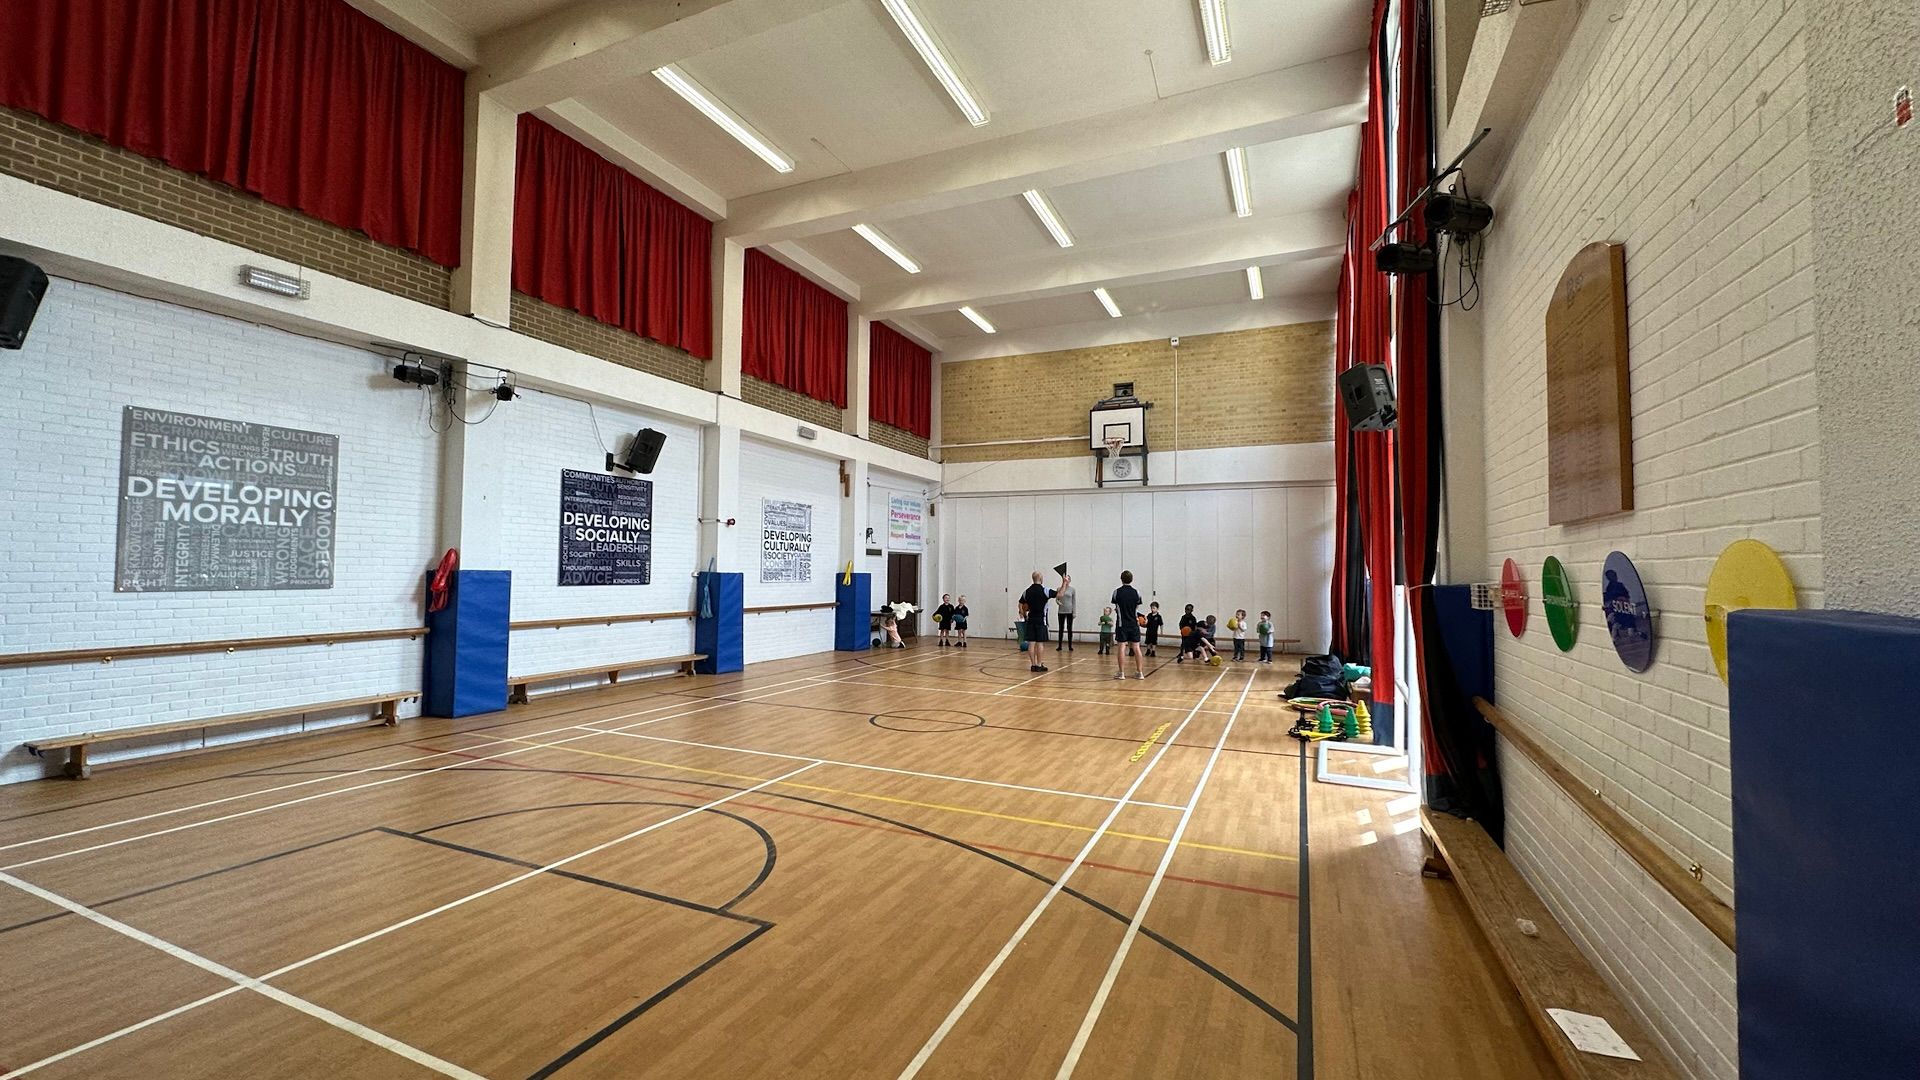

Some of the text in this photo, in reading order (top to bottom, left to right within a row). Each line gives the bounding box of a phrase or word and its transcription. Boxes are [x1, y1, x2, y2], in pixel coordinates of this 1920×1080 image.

[132, 409, 253, 434] ENVIRONMENT
[132, 420, 261, 445] DISCRIMINATION
[271, 430, 333, 447] CULTURE
[130, 432, 221, 455] ETHICS
[221, 443, 260, 452] FEELINGS
[262, 426, 271, 460] REASON
[221, 449, 261, 460] WRONG
[270, 448, 333, 467] TRUTH
[198, 455, 296, 477] ACTIONS
[564, 470, 615, 484] COMMUNITIES
[127, 476, 333, 510] DEVELOPING
[577, 480, 616, 493] BEAUTY
[162, 502, 310, 527] MORALLY
[563, 502, 612, 515] CONFLICT
[890, 509, 921, 521] Perseverance
[563, 512, 650, 531] DEVELOPING
[128, 497, 144, 572] KNOWLEDGE
[576, 528, 640, 543] SOCIALLY
[763, 530, 812, 543] DEVELOPING
[153, 521, 166, 569] FEELINGS
[210, 524, 221, 571] DILEMMAS
[297, 527, 316, 579] RACE
[315, 511, 331, 579] MODELS
[590, 542, 649, 553] LEADERSHIP
[763, 540, 811, 553] CULTURALLY
[174, 522, 191, 588] INTEGRITY
[229, 550, 274, 558] JUSTICE
[275, 527, 291, 585] WRONG
[767, 551, 794, 560] SOCIETY
[616, 559, 642, 568] SKILLS
[210, 568, 250, 578] VALUES
[562, 572, 613, 585] ADVICE
[122, 578, 165, 588] RIGHT
[1612, 599, 1637, 616] SOLENT
